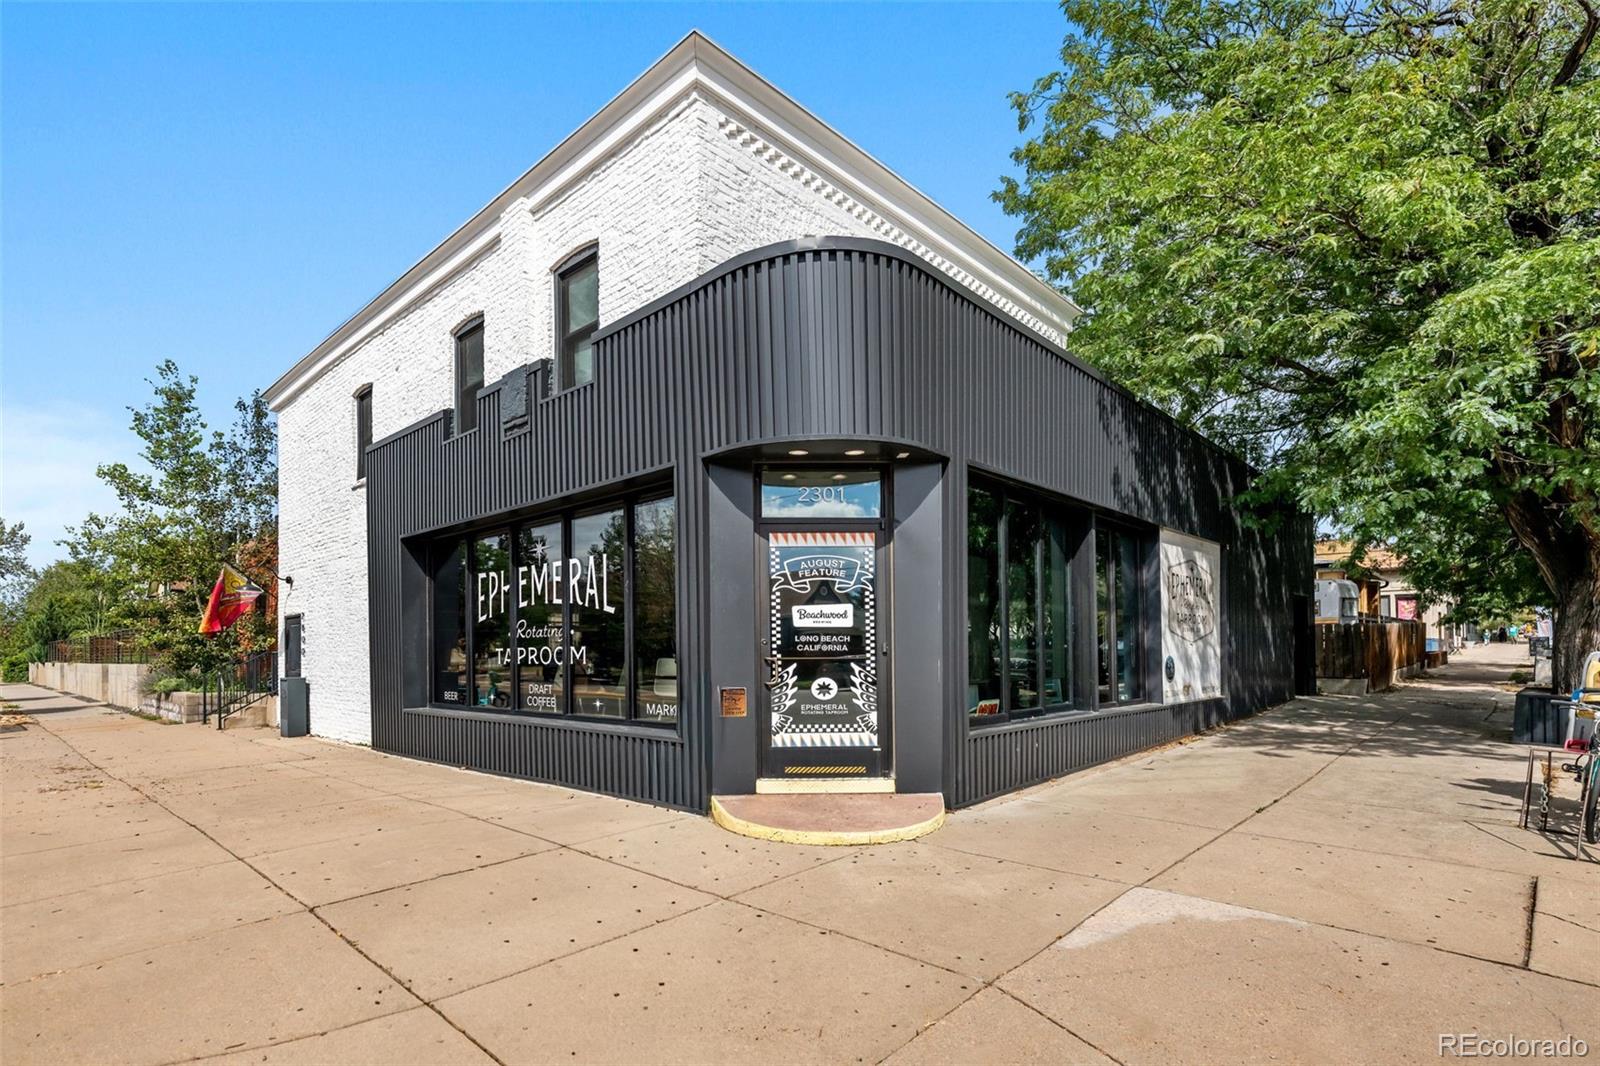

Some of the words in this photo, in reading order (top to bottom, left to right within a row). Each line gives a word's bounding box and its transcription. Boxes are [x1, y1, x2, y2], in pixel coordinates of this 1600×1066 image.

[798, 486, 845, 502] 2301
[800, 559, 845, 569] AUGUST
[798, 569, 847, 577] FEATURE
[478, 553, 615, 622] EPHEMERAL
[796, 608, 849, 620] Beachwood
[496, 645, 587, 665] TAPROOM
[444, 690, 458, 700] BEER
[528, 683, 553, 695] DRAFT
[526, 695, 556, 707] COFFEE
